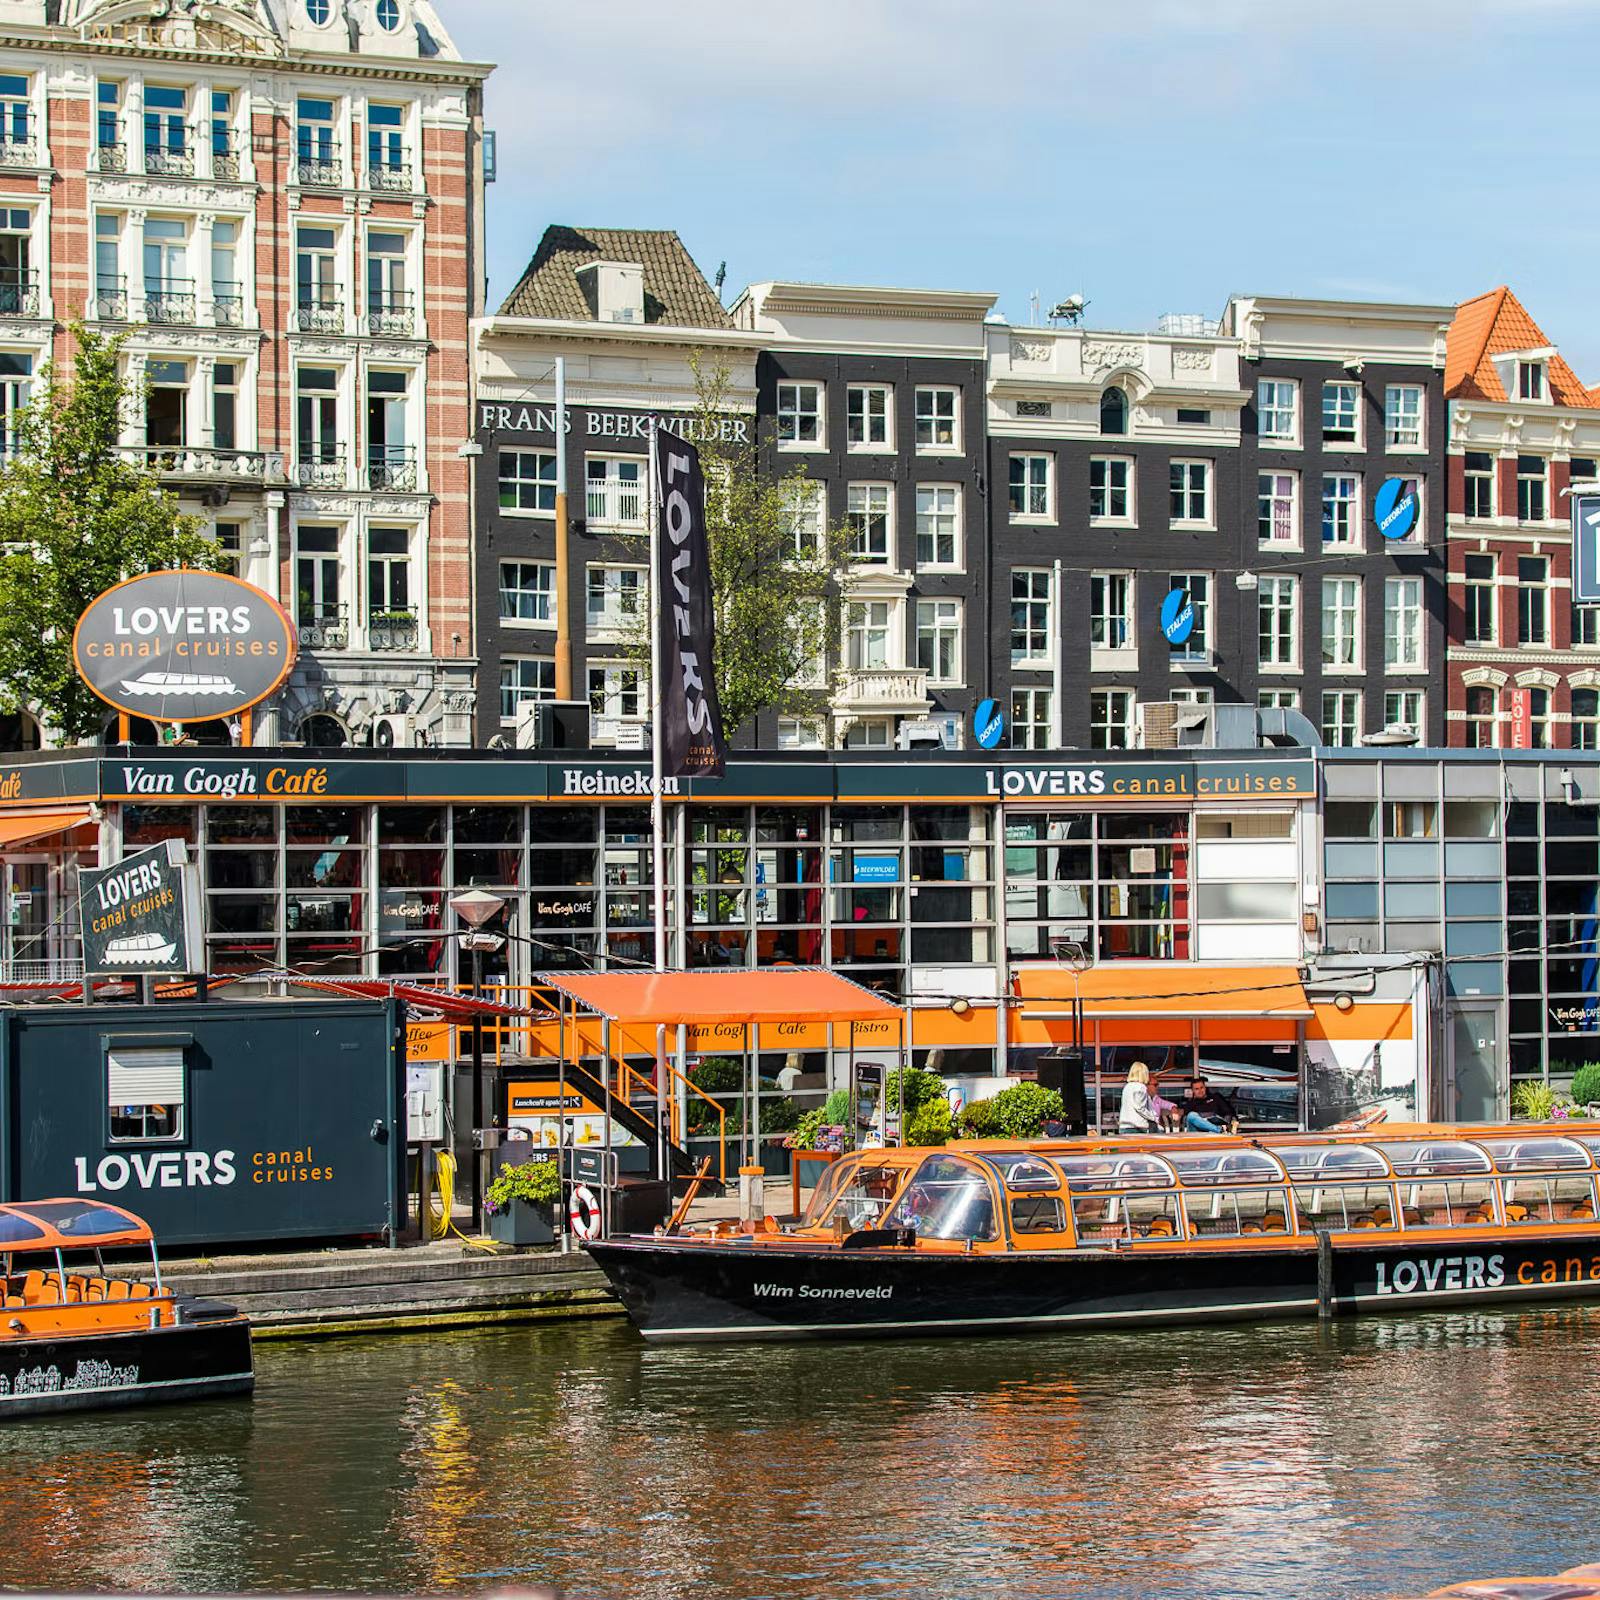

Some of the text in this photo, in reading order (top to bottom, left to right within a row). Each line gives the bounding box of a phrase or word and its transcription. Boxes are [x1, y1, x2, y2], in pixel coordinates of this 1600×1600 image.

[481, 405, 571, 434] FRANS
[113, 606, 251, 635] LOVERS
[1166, 604, 1193, 638] ETALAGE
[86, 637, 278, 657] canal cruises
[122, 766, 328, 799] Van Gogh Café
[986, 770, 1297, 795] LOVERS canal cruises
[97, 859, 162, 910] LOVERS
[92, 888, 174, 934] canal cruises
[573, 901, 592, 913] CAFÉ
[405, 1027, 433, 1040] ffee
[852, 1022, 889, 1033] Bistro
[252, 1147, 313, 1165] canal
[75, 1150, 236, 1192] LOVERS
[252, 1165, 334, 1184] cruises
[1376, 1254, 1505, 1294] LOVERS
[753, 1283, 893, 1298] Wim Sonneveld
